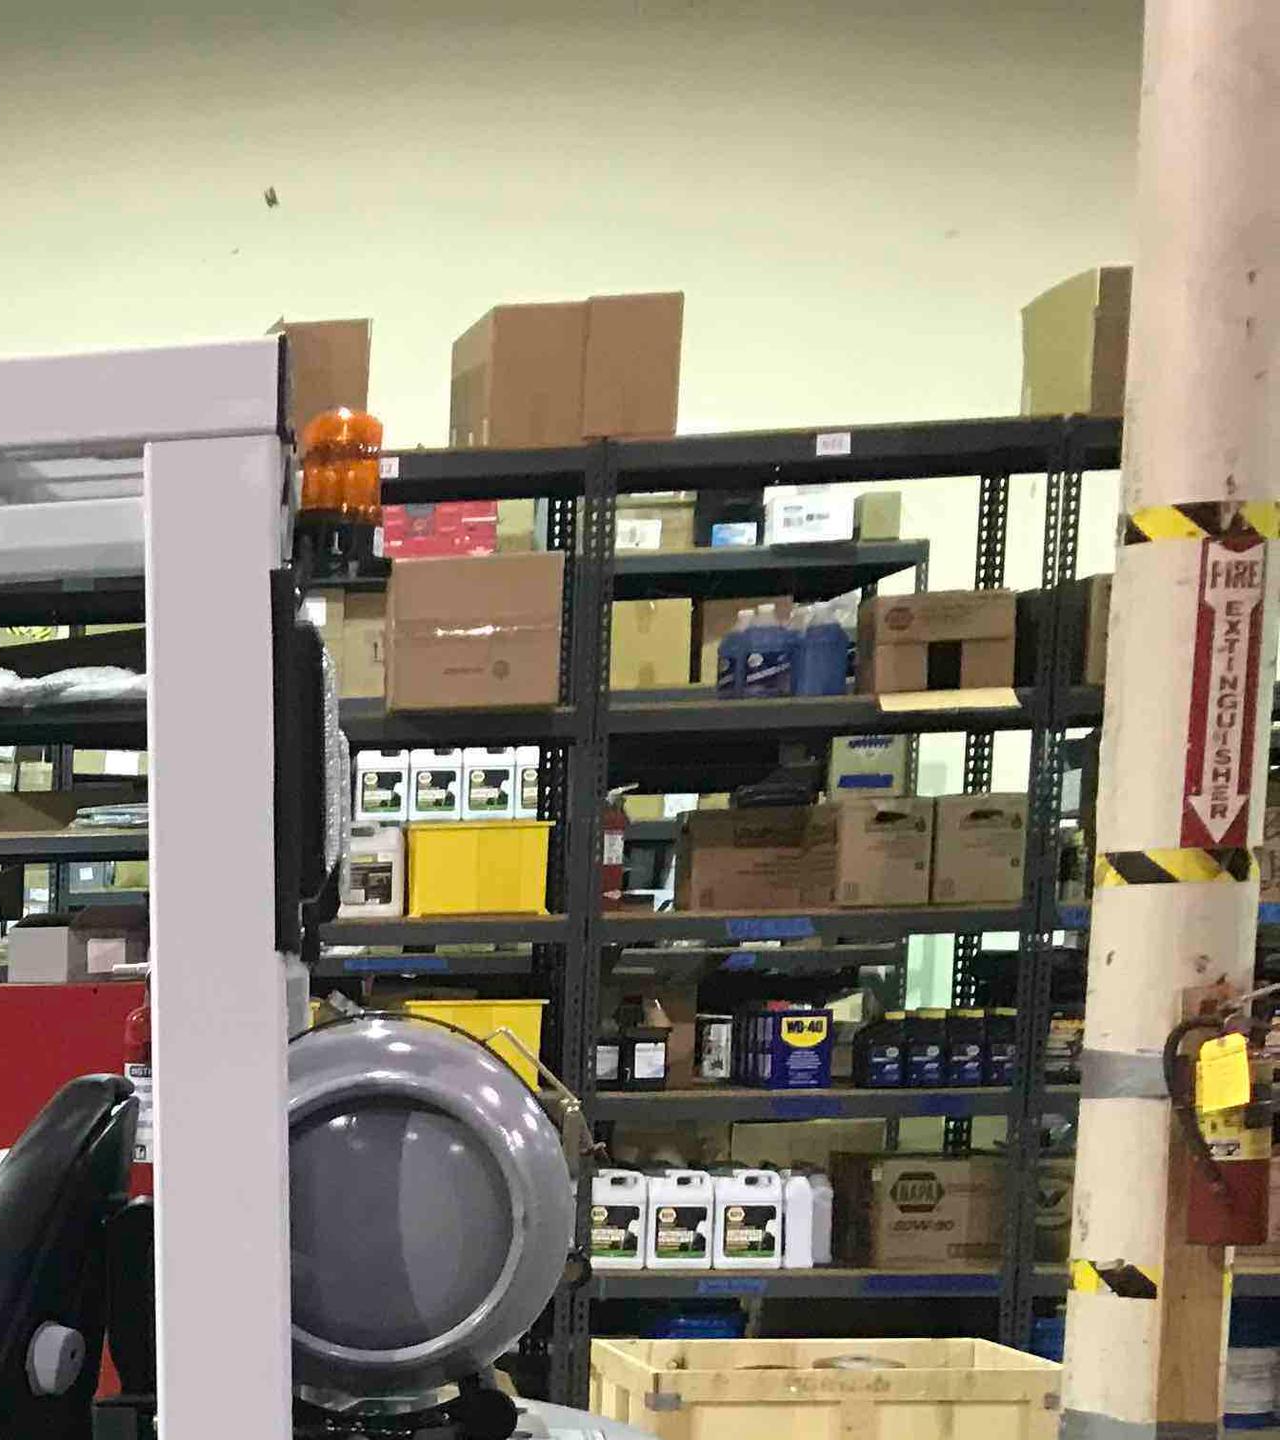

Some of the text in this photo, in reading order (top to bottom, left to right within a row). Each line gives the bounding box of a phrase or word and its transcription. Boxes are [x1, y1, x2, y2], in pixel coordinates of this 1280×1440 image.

[1210, 560, 1261, 589] FIRE
[1210, 600, 1242, 820] EXTINGUISHER
[786, 1020, 824, 1033] WD-40
[897, 1181, 940, 1203] NAPA
